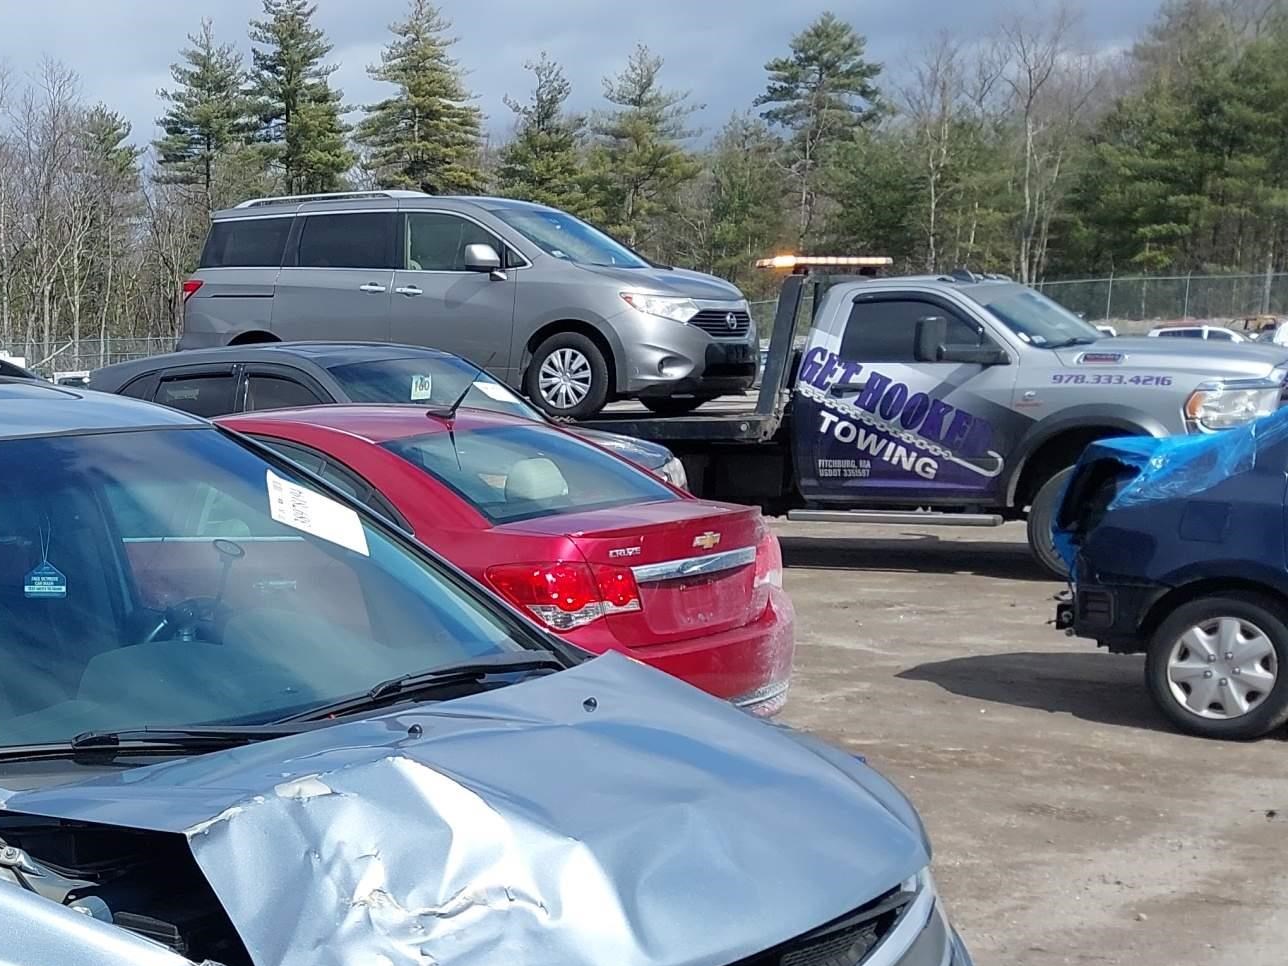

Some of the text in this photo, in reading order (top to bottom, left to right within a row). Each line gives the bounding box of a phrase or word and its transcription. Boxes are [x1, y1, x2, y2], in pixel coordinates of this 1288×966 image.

[799, 346, 993, 453] GET HOOKED
[1052, 374, 1173, 386] 978.333.4216
[818, 411, 939, 479] TOWING
